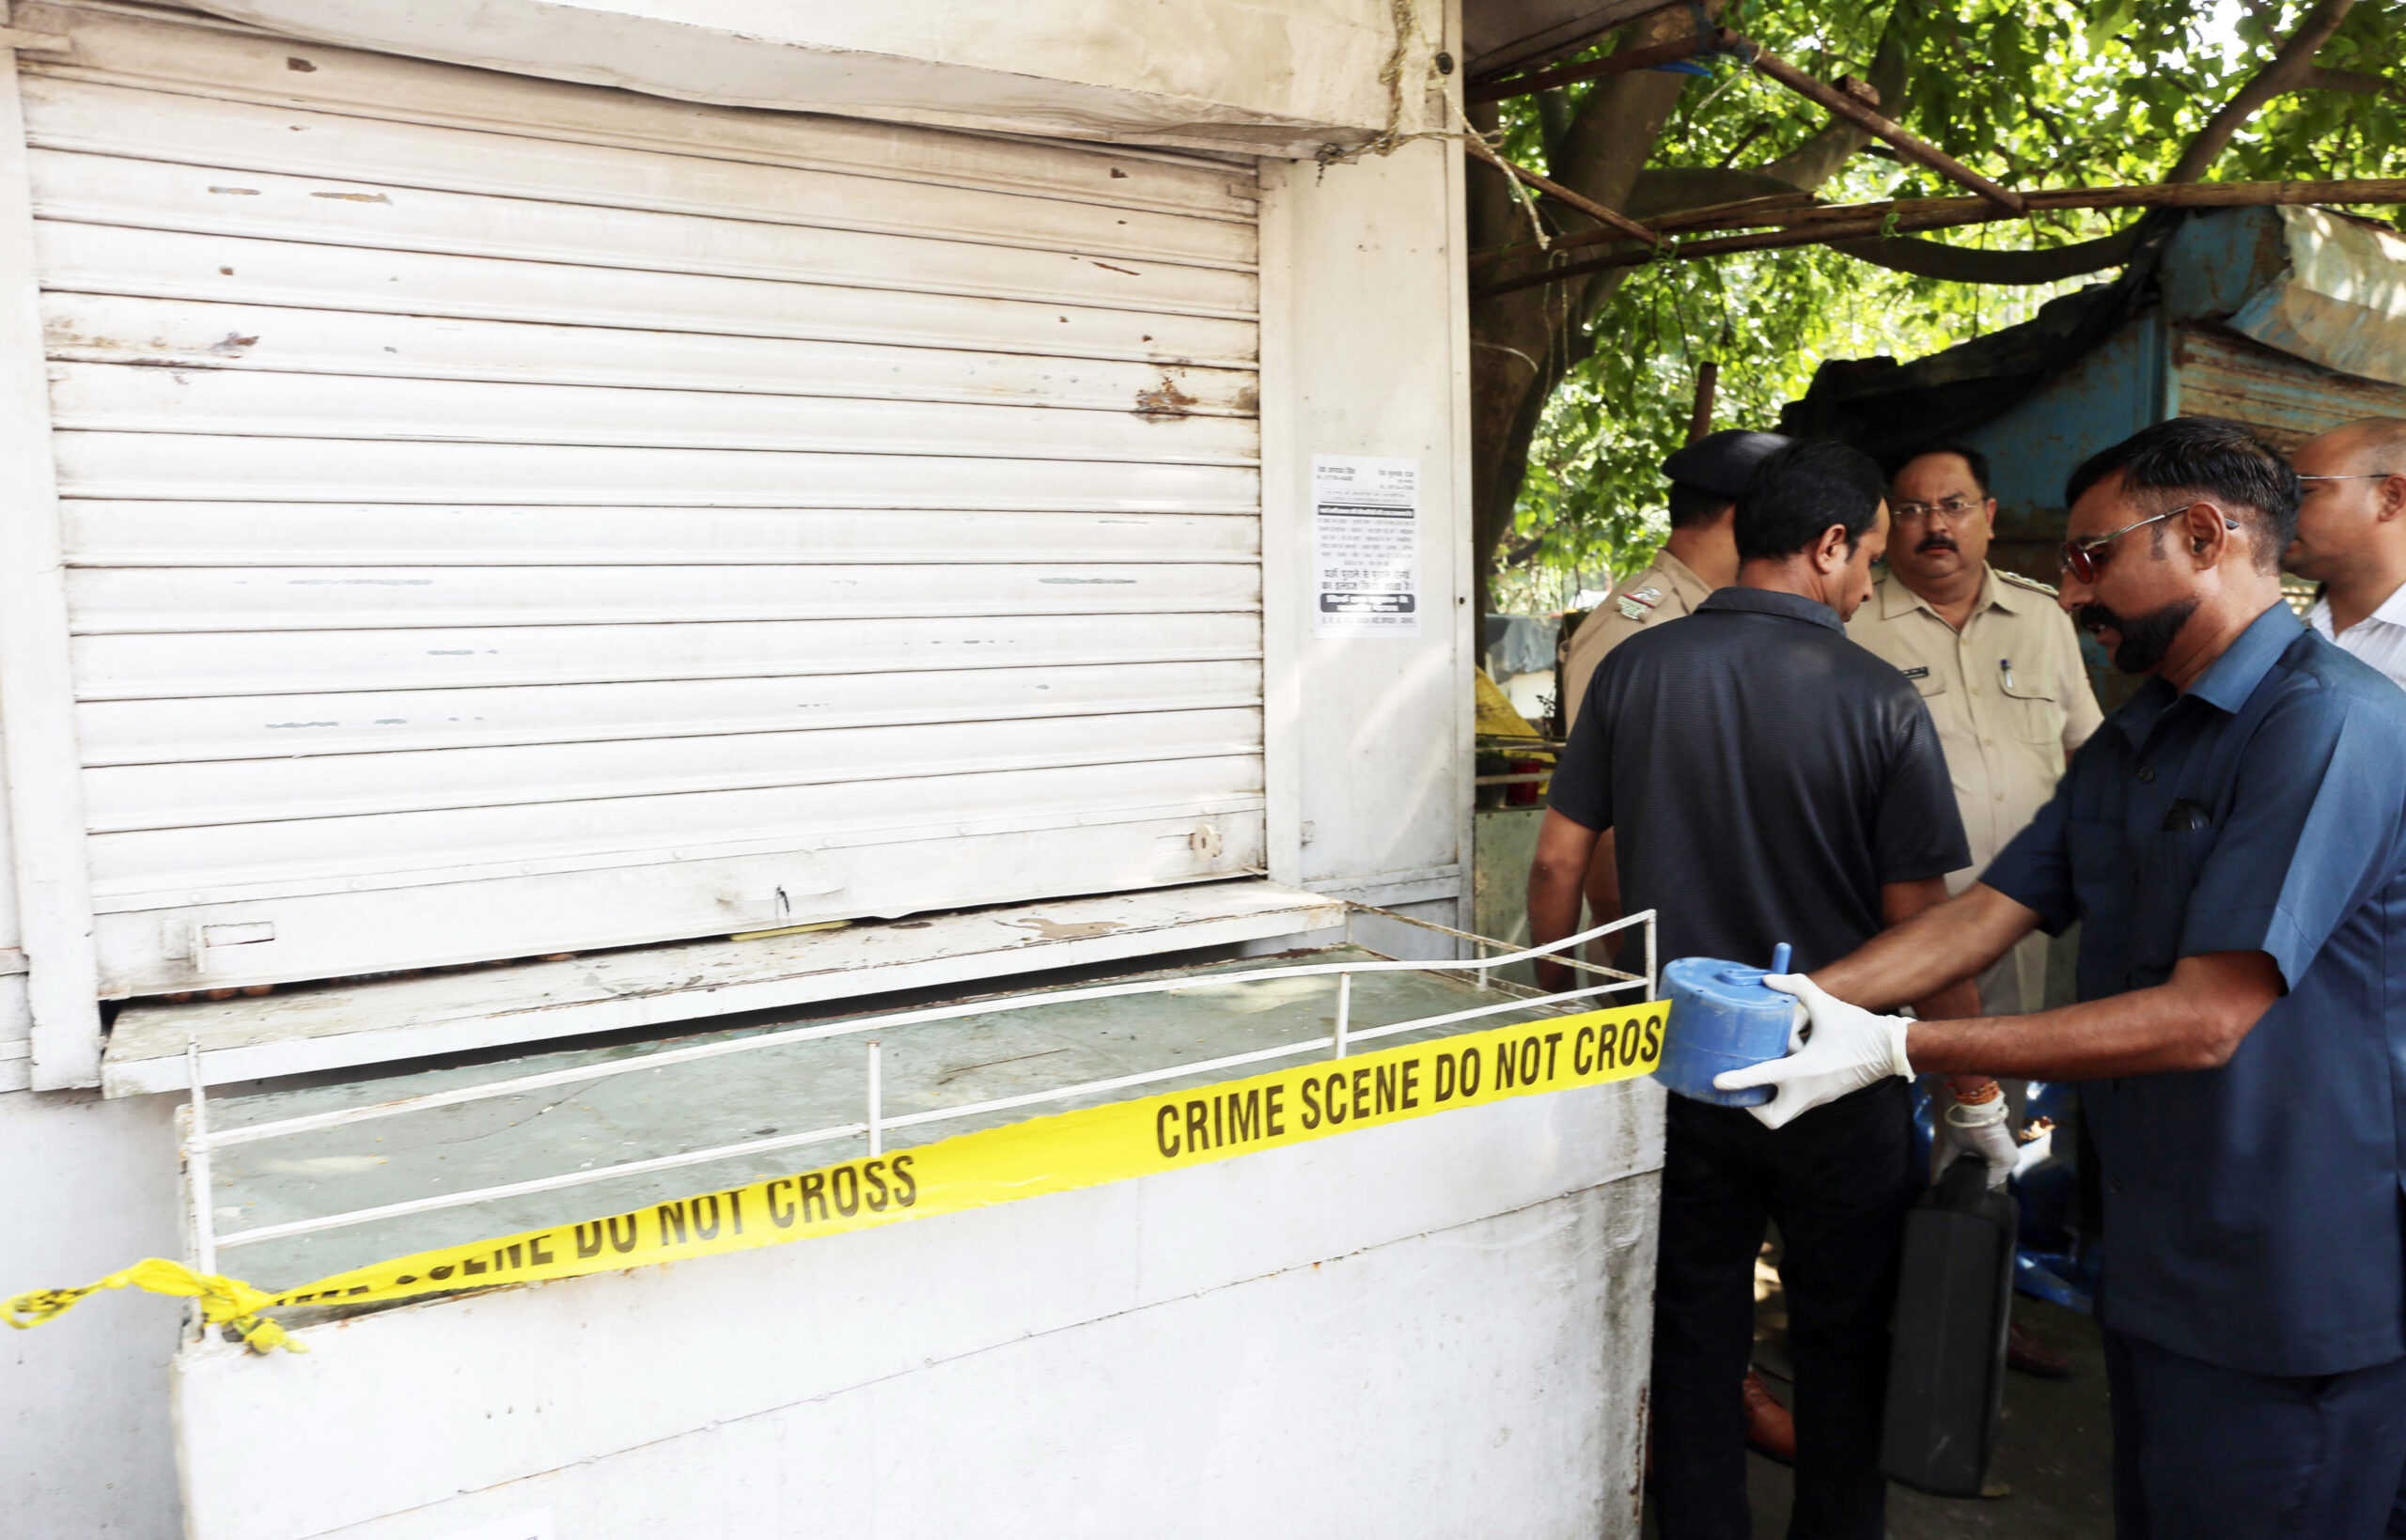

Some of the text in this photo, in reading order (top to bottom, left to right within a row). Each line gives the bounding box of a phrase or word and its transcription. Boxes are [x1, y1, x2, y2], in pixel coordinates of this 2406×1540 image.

[1157, 1085, 1285, 1158] CRIME
[1301, 1059, 1419, 1130] SCENE
[1435, 1048, 1481, 1103] DO
[1495, 1032, 1564, 1091] NOT
[575, 1214, 636, 1258] DO
[657, 1189, 747, 1247] NOT
[767, 1155, 916, 1228] CROSS
